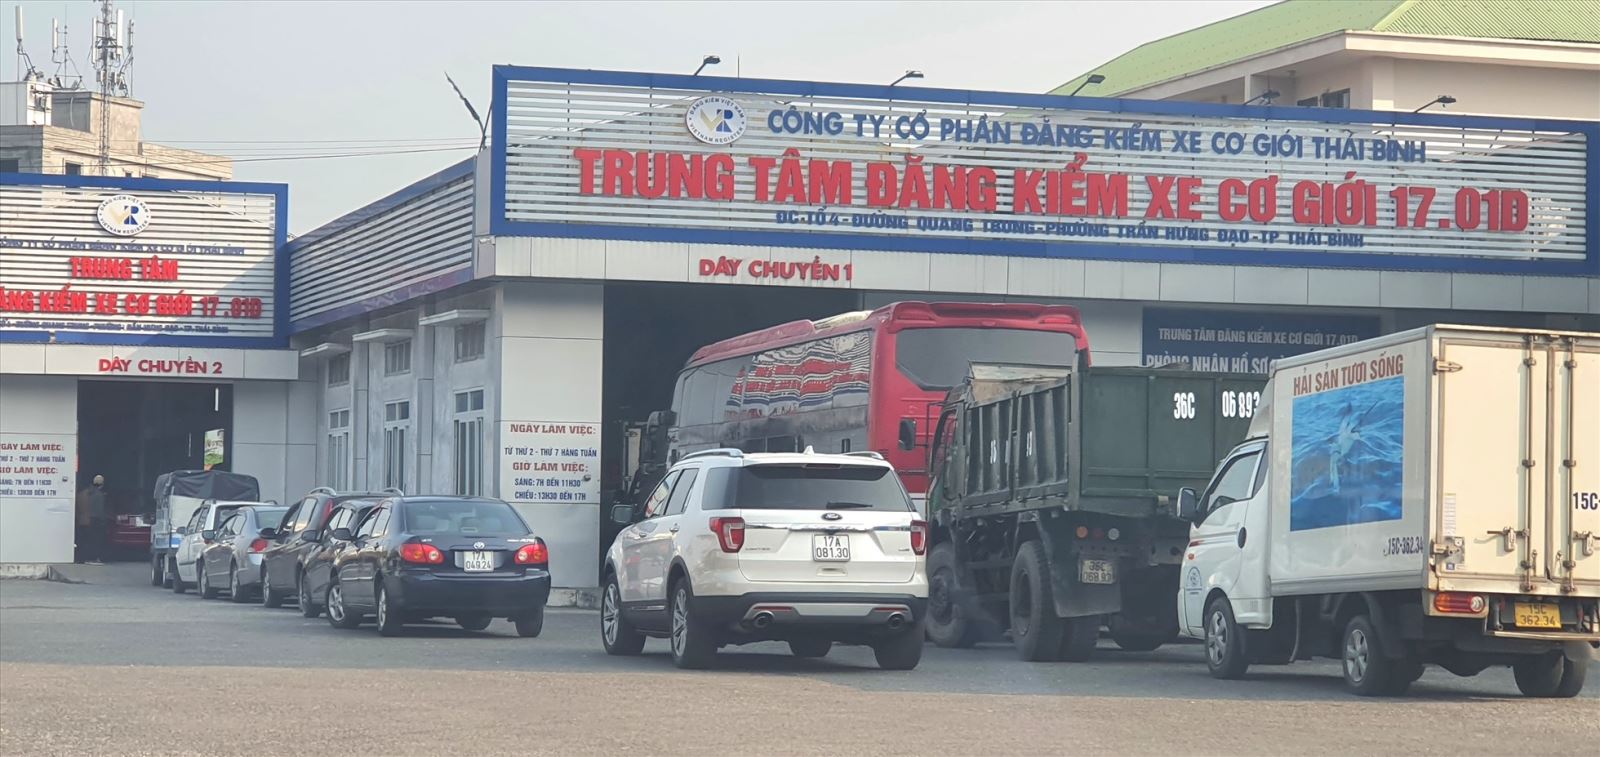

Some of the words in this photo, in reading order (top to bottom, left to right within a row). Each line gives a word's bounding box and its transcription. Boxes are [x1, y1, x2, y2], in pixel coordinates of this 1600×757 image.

[768, 105, 844, 136] CÔNG
[853, 113, 886, 138] TY
[895, 109, 930, 140] CỔ
[940, 113, 1011, 144] PHẦN
[1020, 118, 1095, 148] ĐĂNG
[1104, 122, 1162, 151] KIỂM
[1172, 131, 1201, 154] XE
[1211, 131, 1247, 155] CƠ
[1253, 129, 1303, 158] GIỚI
[1312, 131, 1365, 161] THÁI
[574, 148, 735, 200] TRUNG
[749, 148, 852, 206] TÂM
[866, 154, 997, 212] ĐĂNG
[1013, 152, 1128, 218] KIỂM
[1144, 175, 1203, 221] XE
[1218, 175, 1279, 223] CƠ
[1292, 171, 1377, 227] GIỚI
[916, 216, 973, 232] QUANG
[1118, 220, 1159, 239] TRẦN
[1165, 226, 1209, 242] HƯNG
[1287, 228, 1322, 246] THÁI
[1327, 228, 1364, 248] BÌNH
[70, 256, 132, 280] TRUNG
[139, 255, 178, 281] TÂM
[699, 255, 742, 276] DÂY
[843, 264, 852, 281] 1
[0, 286, 34, 312] ĂNG
[39, 283, 87, 313] KIỂM
[95, 292, 118, 315] XE
[124, 293, 150, 315] CƠ
[156, 289, 192, 317] GIỚI
[1159, 327, 1192, 341] TRUNG
[1193, 326, 1216, 341] TÂM
[1217, 328, 1245, 343] ĐĂNG
[1247, 326, 1272, 344] KIỂM
[1274, 331, 1287, 344] XE
[1288, 331, 1302, 345] CƠ
[1304, 329, 1324, 346] GIỚI
[98, 356, 132, 372] DÂY
[212, 362, 223, 374] 2
[1232, 351, 1249, 373] HỒ
[1293, 366, 1312, 396] HẢI
[1315, 362, 1339, 392] SẢN
[1341, 361, 1367, 386] TƯƠI
[1370, 351, 1404, 380] SỐNG
[1173, 391, 1195, 419] 36C
[510, 423, 540, 433] NGÀY
[542, 424, 566, 434] LÀM
[554, 448, 559, 456] 7
[533, 460, 558, 471] LÀM
[514, 477, 535, 487] SÁNG:
[536, 478, 544, 486] 7H
[546, 476, 559, 487] ĐẾN
[561, 479, 581, 487] 11H30
[538, 492, 558, 500] 13H30
[559, 490, 572, 500] ĐẾN
[574, 492, 586, 501] 17H
[823, 536, 841, 547] 17A
[472, 551, 486, 560] 17A
[816, 547, 849, 558] 081.30
[1529, 604, 1547, 615] 15C
